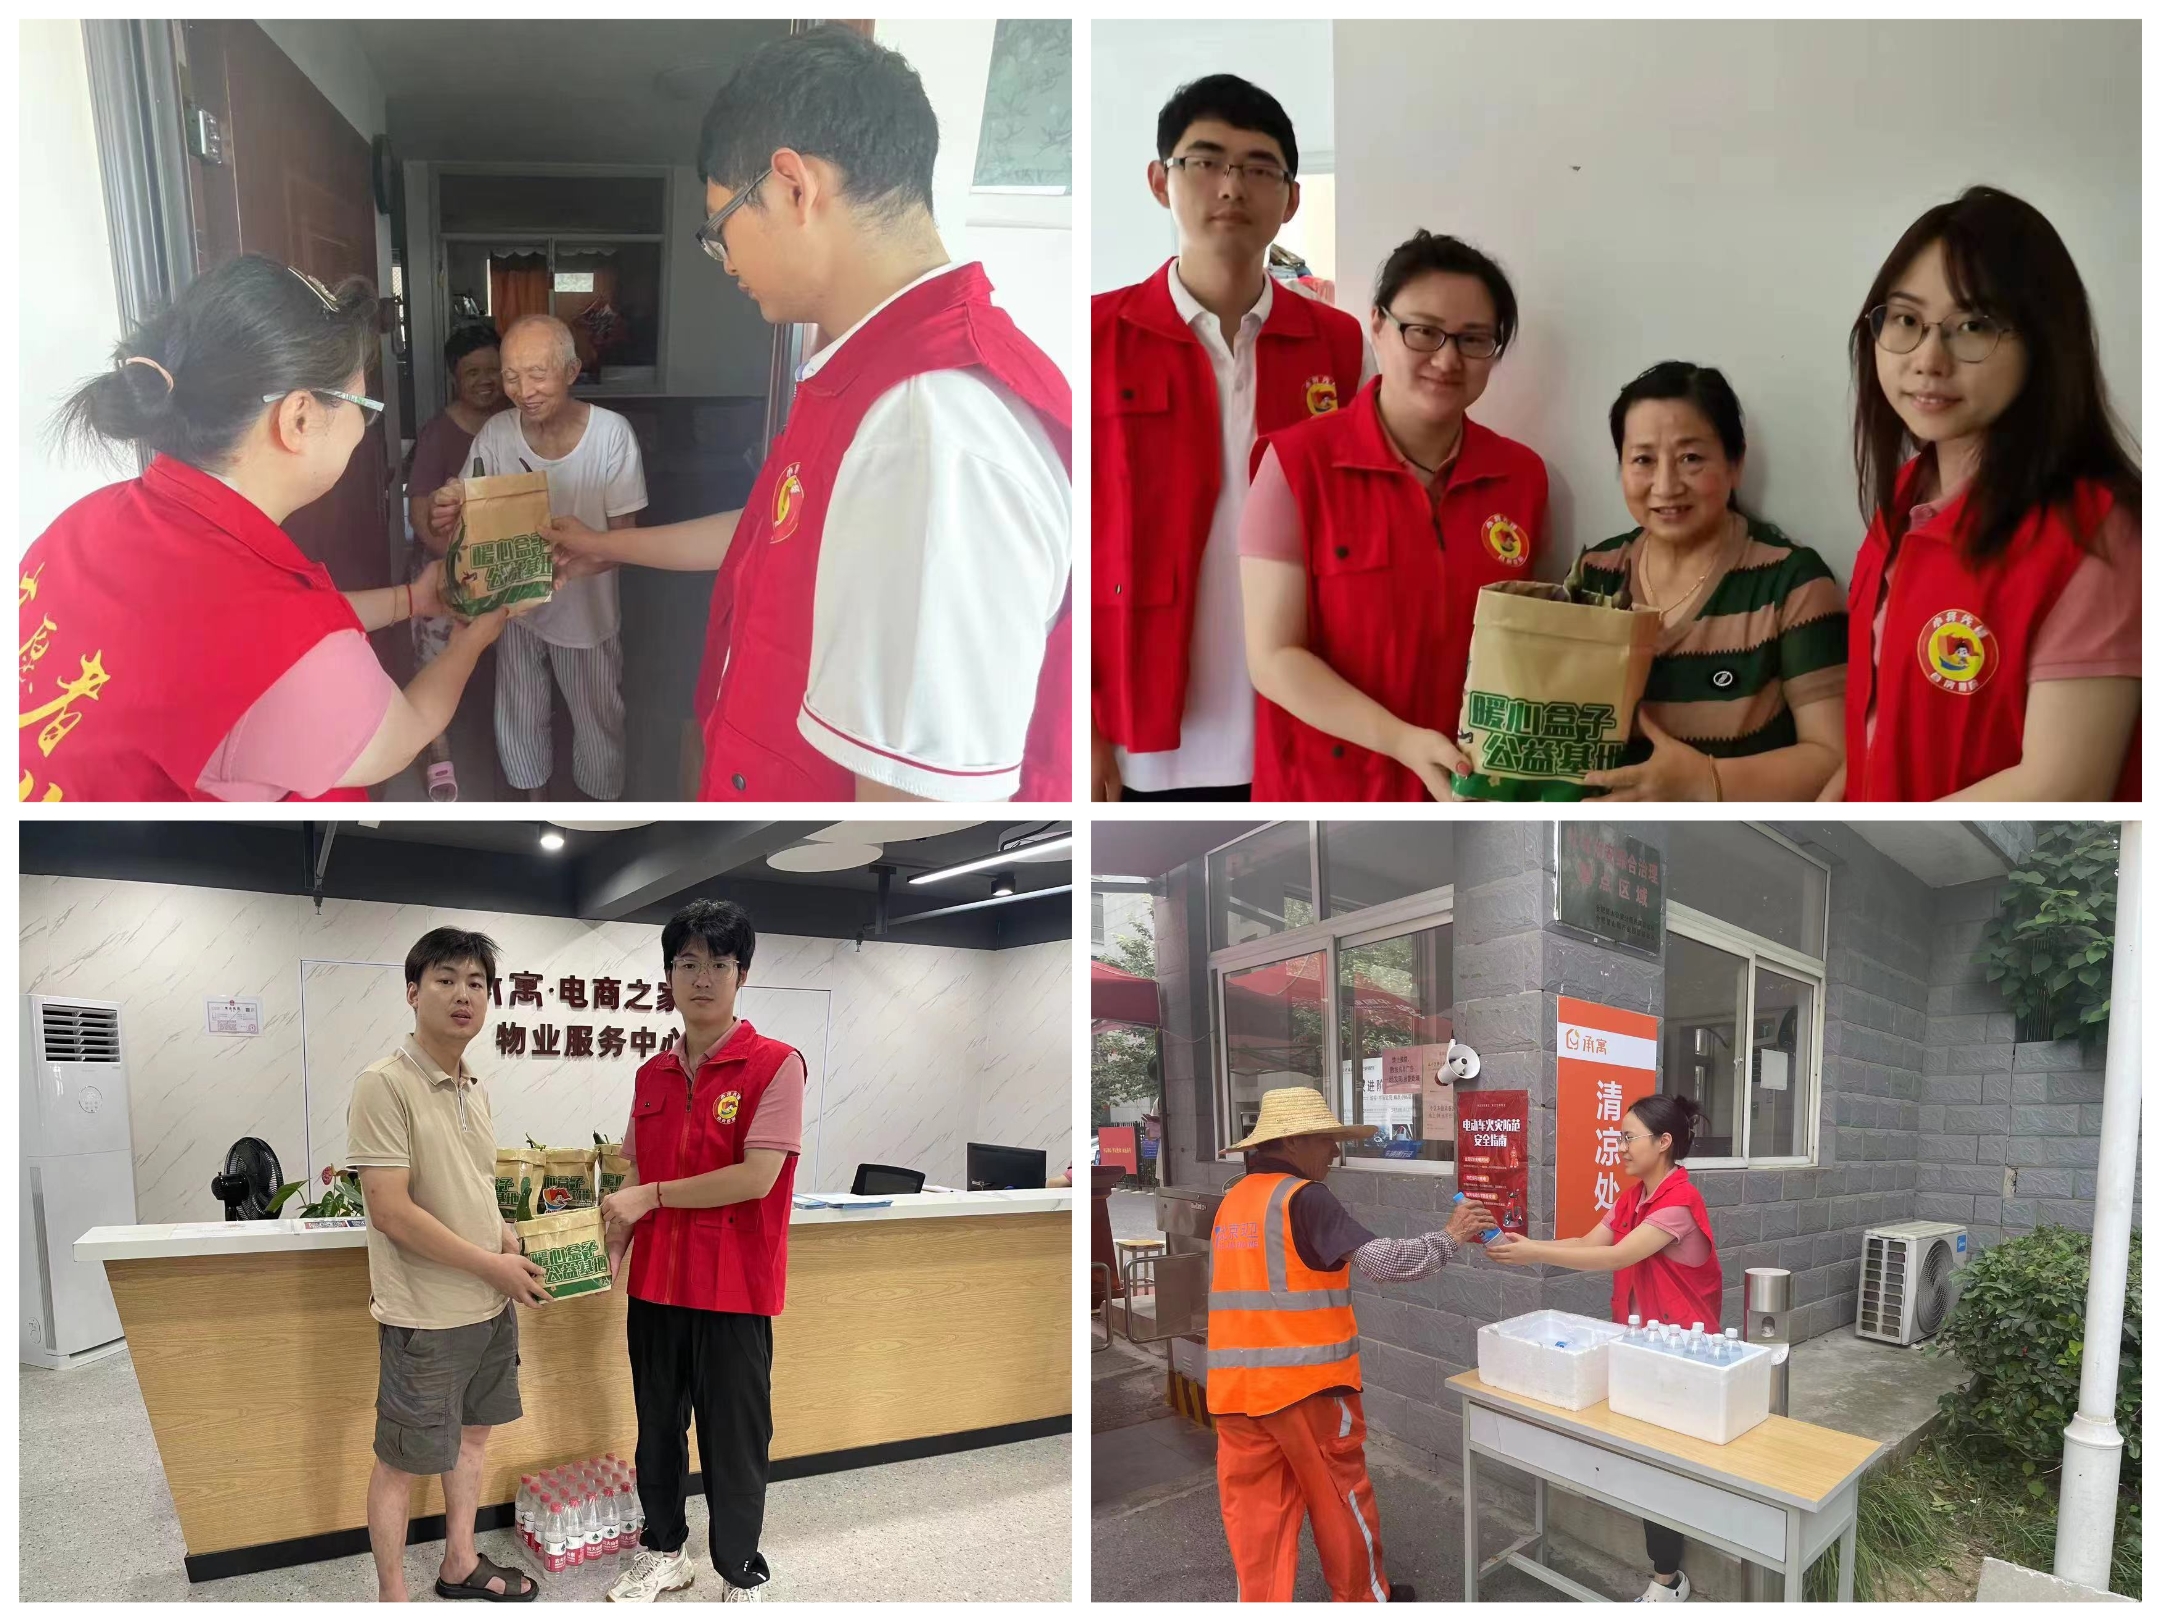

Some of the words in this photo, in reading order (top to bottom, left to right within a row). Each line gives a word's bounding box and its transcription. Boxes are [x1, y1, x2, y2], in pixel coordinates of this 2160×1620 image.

[1469, 691, 1617, 740] 暖心盒子
[1462, 1118, 1521, 1132] 电动车火灾防范
[1474, 1133, 1507, 1147] 安全指南
[1594, 1080, 1623, 1212] 清凉处
[529, 1239, 599, 1267] 暖心盒子
[545, 1254, 608, 1284] 公益基地
